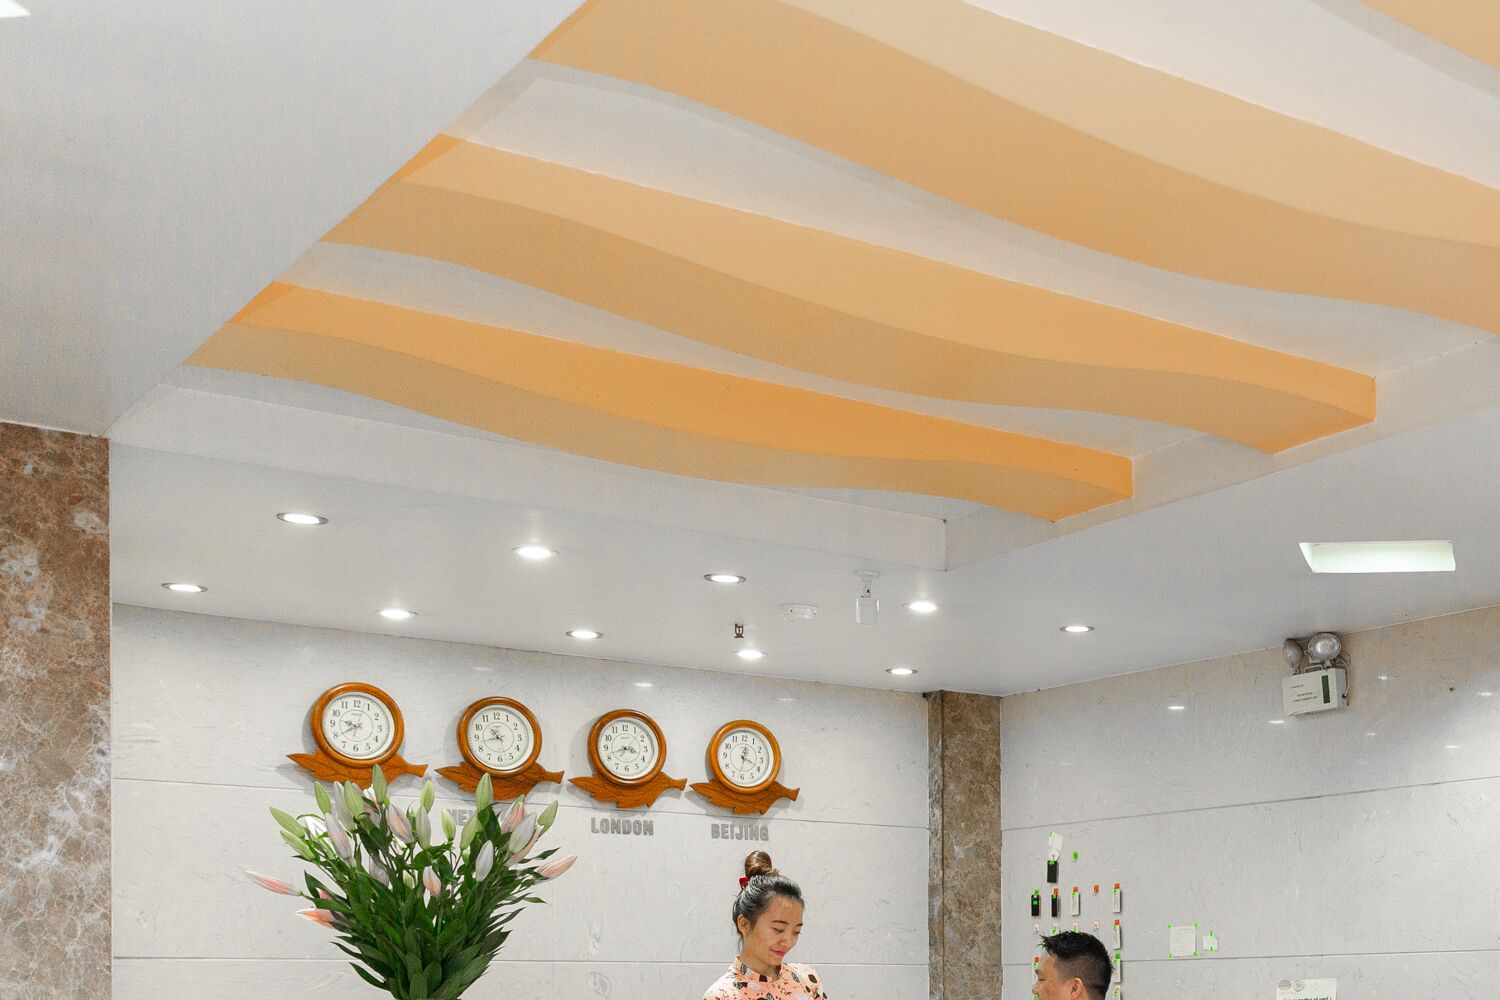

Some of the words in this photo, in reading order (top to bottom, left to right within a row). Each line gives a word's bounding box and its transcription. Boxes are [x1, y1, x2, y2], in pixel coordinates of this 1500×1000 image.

[341, 701, 348, 709] 11
[353, 700, 361, 708] 12
[332, 709, 341, 717] 10
[493, 712, 500, 720] 12
[373, 735, 378, 743] 4
[590, 817, 654, 836] LONDON
[710, 823, 769, 841] BEIJING
